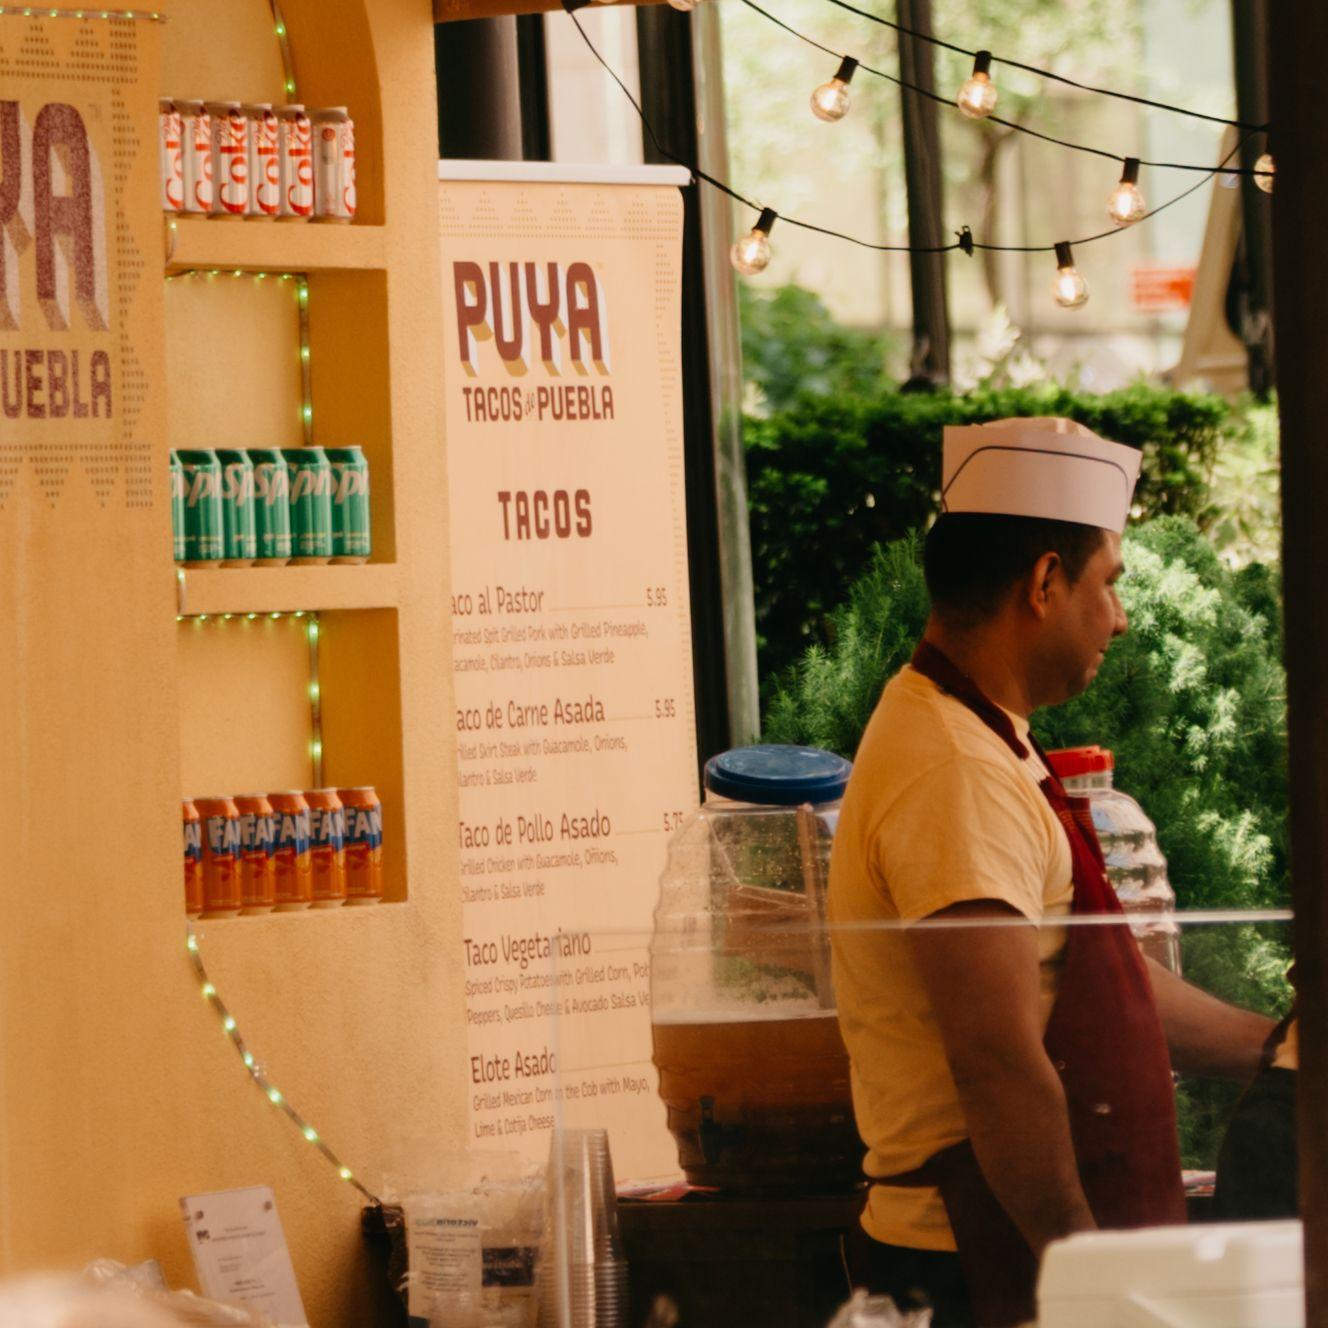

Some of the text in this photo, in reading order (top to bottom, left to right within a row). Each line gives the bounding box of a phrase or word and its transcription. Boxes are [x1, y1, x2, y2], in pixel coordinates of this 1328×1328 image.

[452, 260, 610, 378] PUYA
[462, 387, 523, 422] TACOS
[537, 385, 615, 421] PUEBLA
[497, 489, 593, 540] TACOS
[478, 586, 491, 614] al
[496, 586, 544, 612] Pastor
[646, 587, 667, 607] 5.95
[549, 623, 568, 640] with
[571, 622, 600, 640] Grilled
[603, 620, 648, 640] Pineapple,
[561, 648, 585, 666] Salsa
[589, 647, 614, 664] Verde
[456, 694, 676, 731] aco de Carne Asada 5.95
[524, 740, 541, 756] with
[543, 735, 592, 755] Guacamole,
[594, 734, 628, 752] Onions,
[493, 769, 513, 785] Salsa
[515, 766, 537, 783] Verde
[496, 817, 512, 845] de
[518, 814, 553, 843] Pollo
[561, 809, 611, 840] Asado
[517, 855, 534, 870] with
[536, 852, 582, 869] Guacamole,
[585, 847, 618, 865] Onions,
[501, 882, 521, 899] Salsa
[523, 879, 545, 896] Verde
[464, 928, 591, 969] Taco Vegetariano
[466, 979, 492, 998] Spiced
[495, 976, 518, 994] Crispy
[575, 966, 603, 984] Grilled
[607, 963, 631, 983] Corn,
[467, 1008, 501, 1025] Peppers,
[572, 994, 608, 1014] Avocado
[612, 991, 636, 1009] Salsa
[471, 1046, 557, 1083] Elote Asado
[473, 1092, 501, 1111] Grilled
[502, 1089, 533, 1106] Mexican
[535, 1084, 552, 1103] Corn
[565, 1083, 580, 1099] the
[582, 1080, 598, 1097] Cob
[600, 1078, 619, 1094] with
[622, 1075, 650, 1095] Mayo,
[474, 1119, 495, 1138] Lime
[504, 1117, 526, 1135] Cotija
[529, 1113, 555, 1130] Cheese
